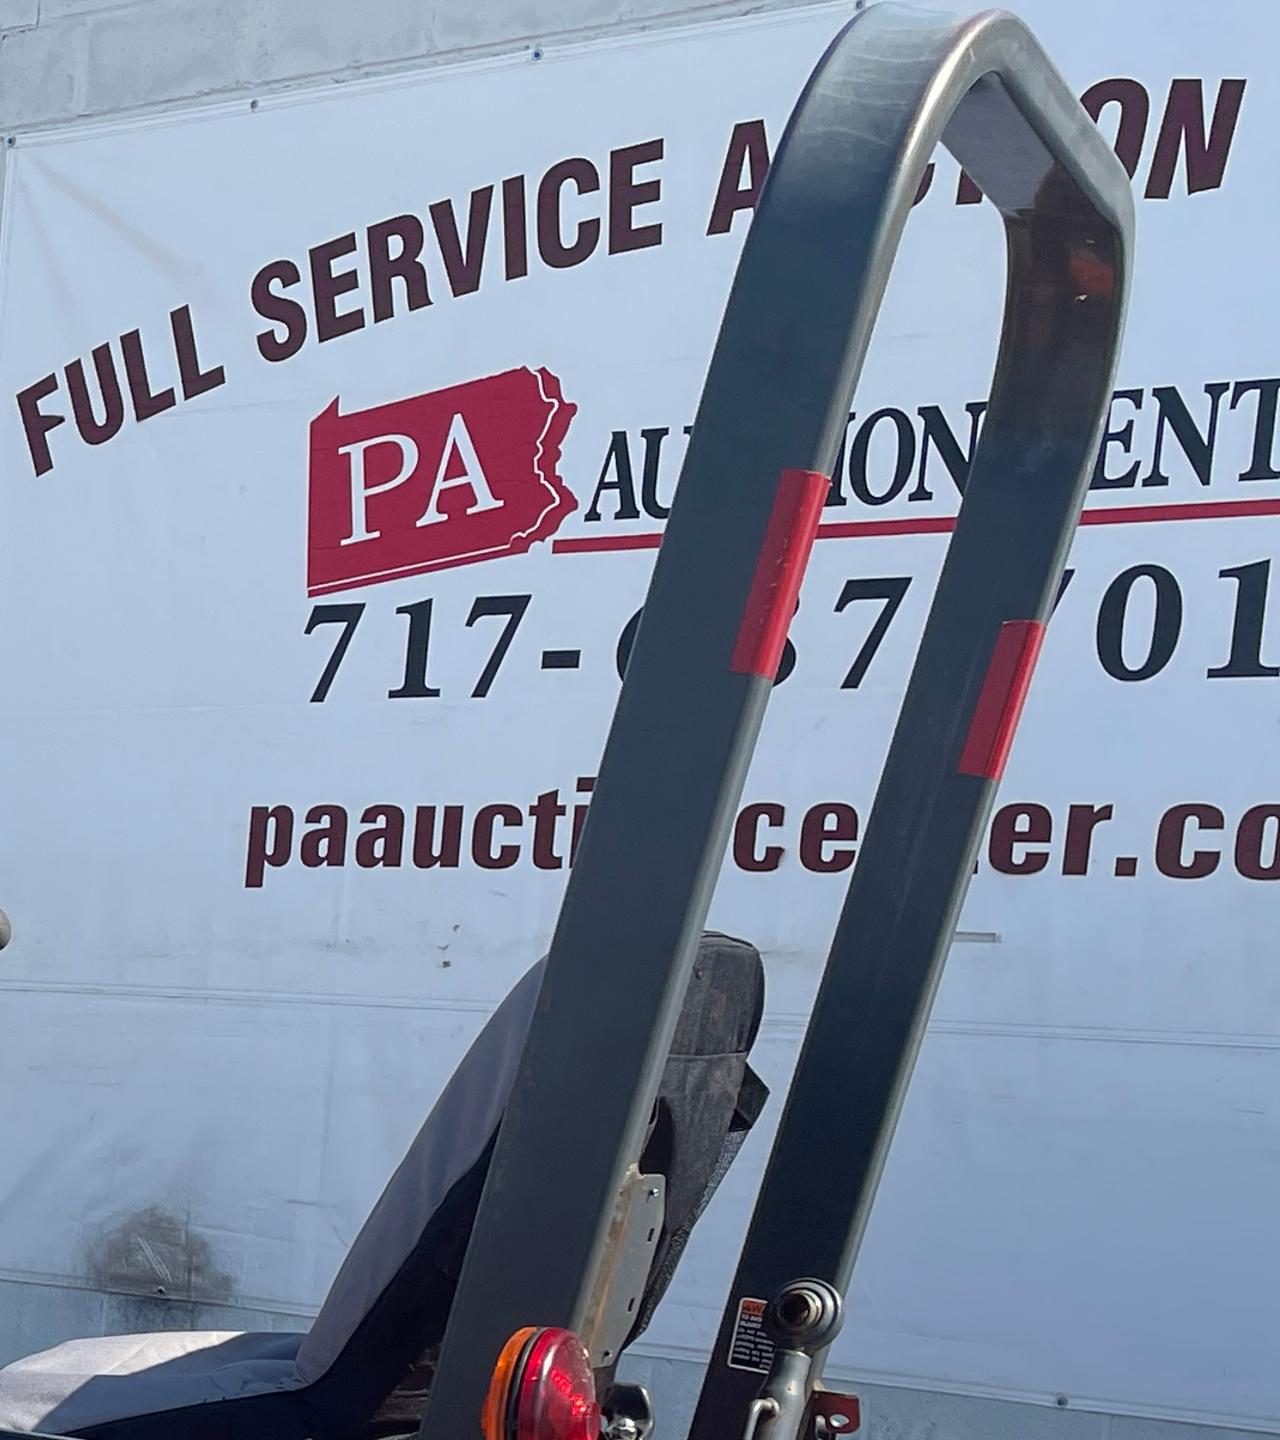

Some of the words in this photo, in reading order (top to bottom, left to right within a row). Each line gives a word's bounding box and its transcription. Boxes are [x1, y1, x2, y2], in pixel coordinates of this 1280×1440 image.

[16, 304, 225, 477] FULL
[251, 138, 663, 362] SERVICE
[338, 413, 504, 547] PA
